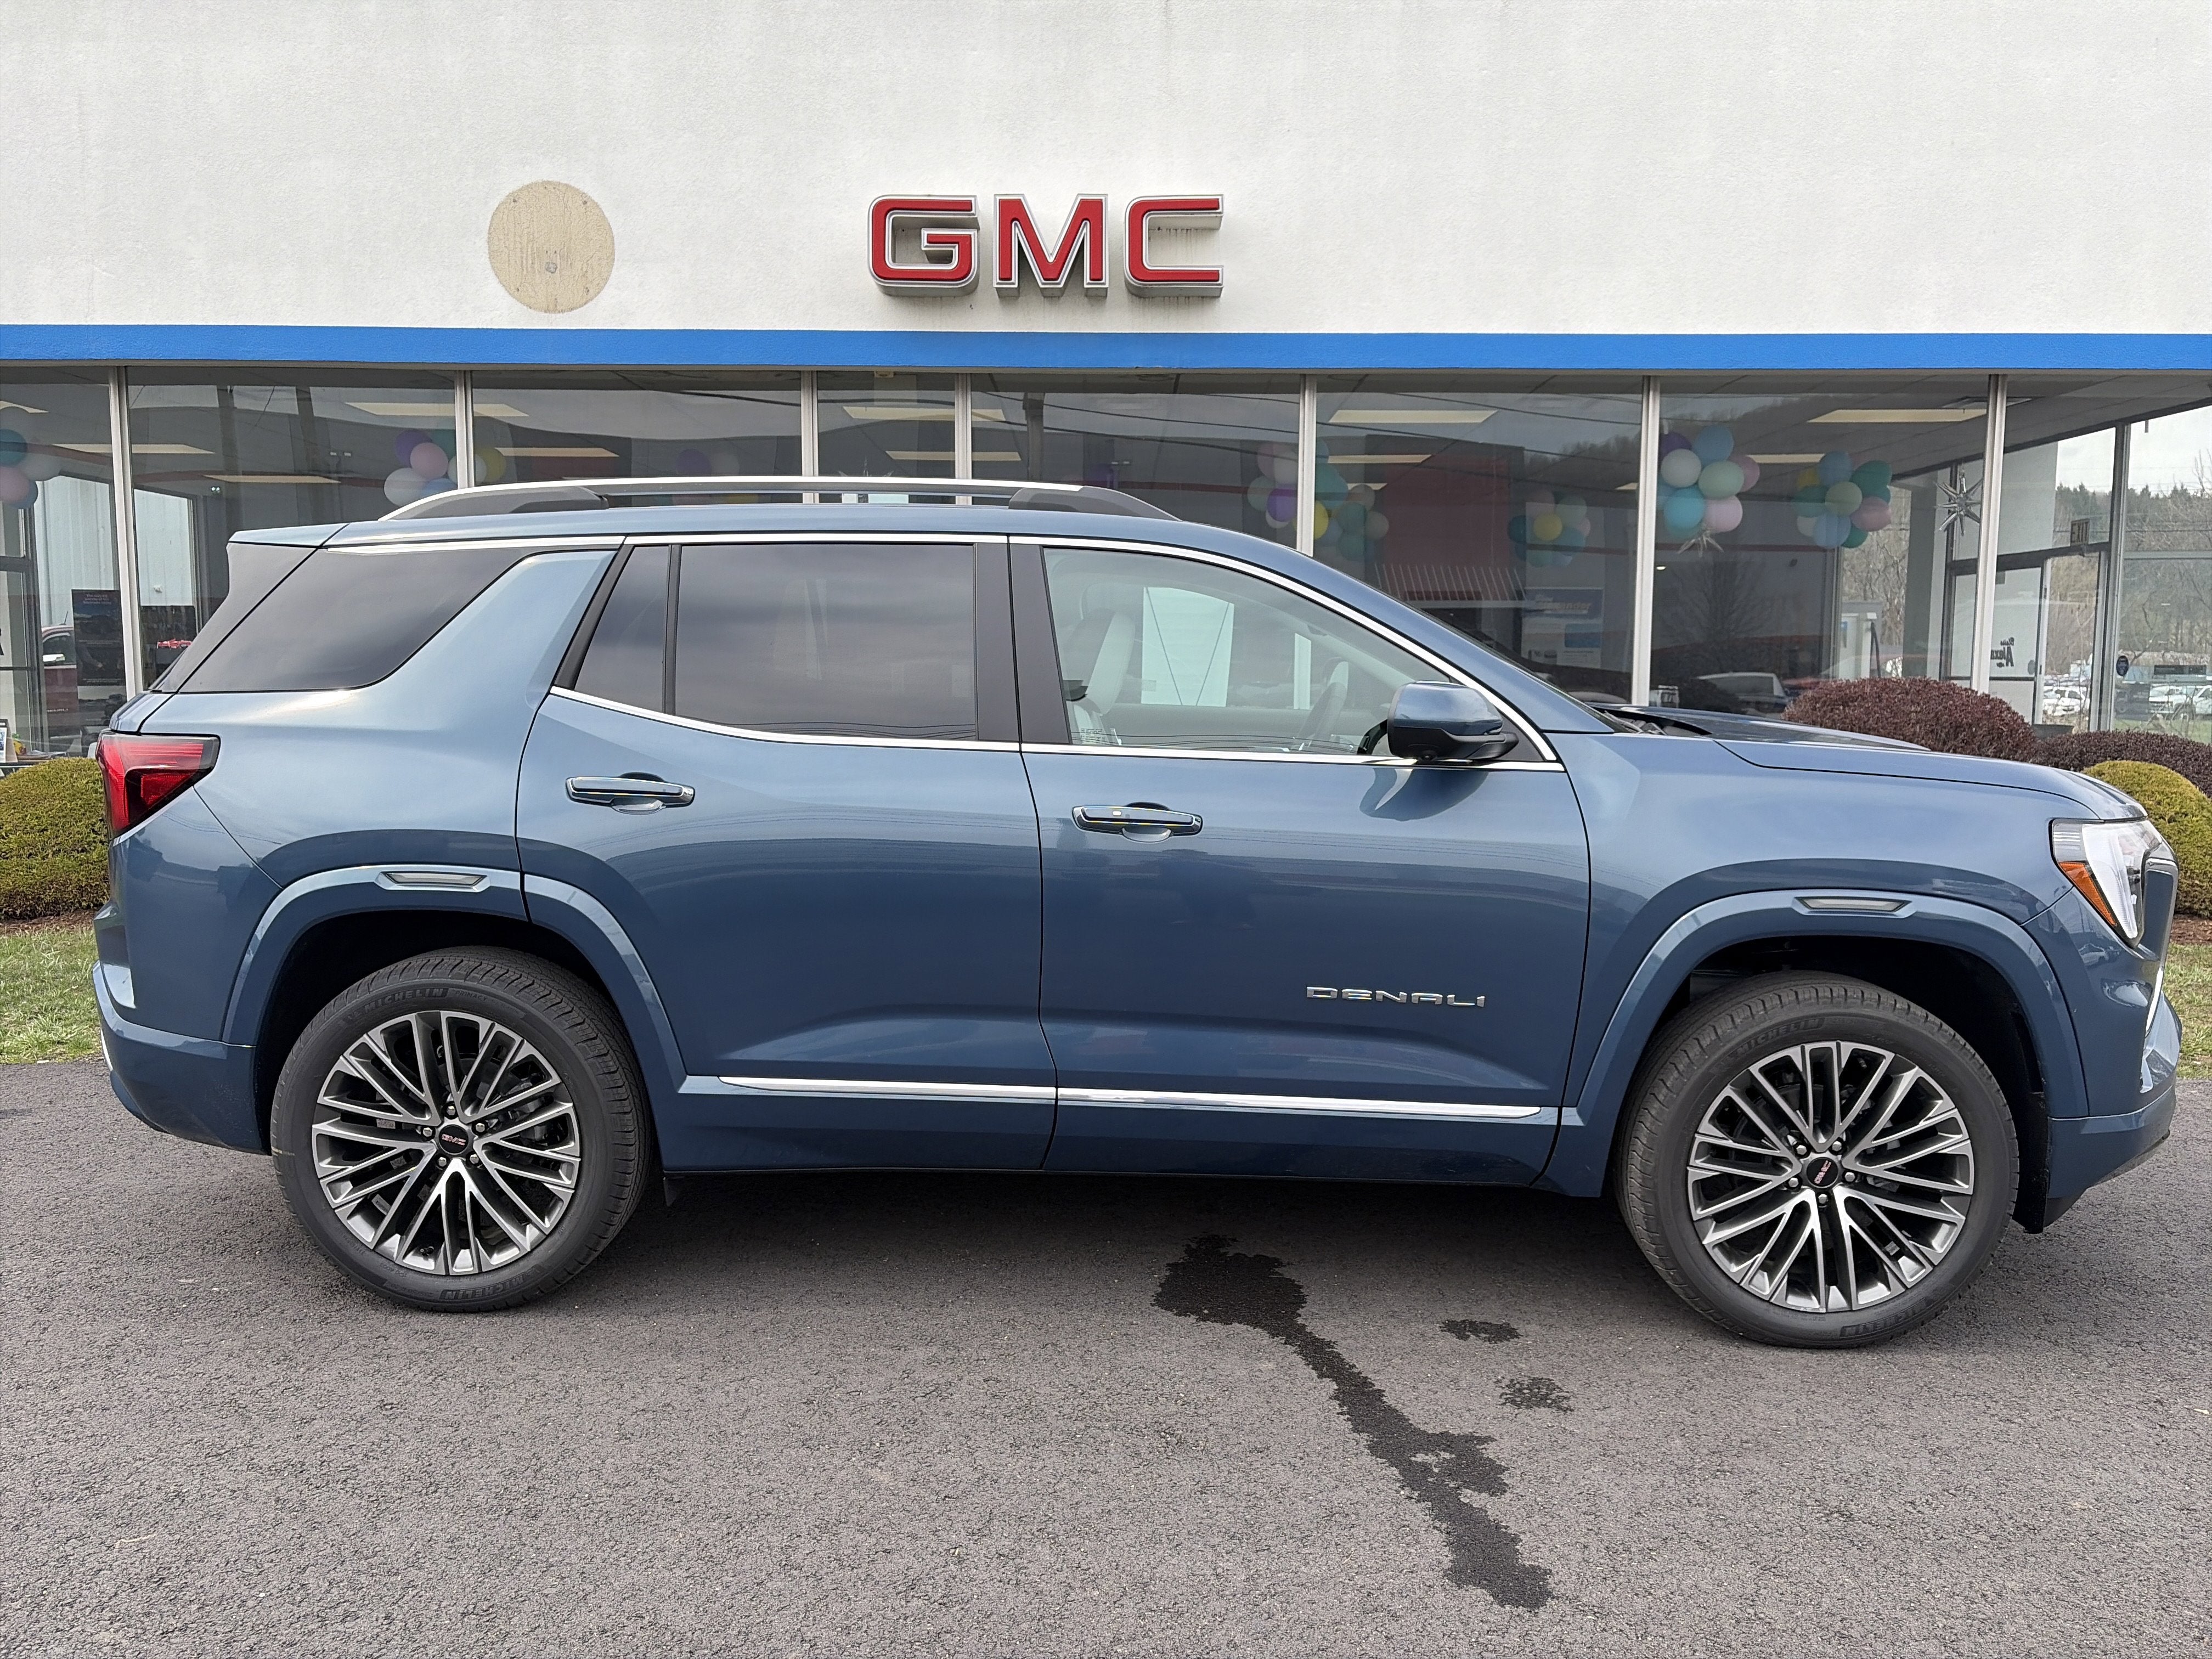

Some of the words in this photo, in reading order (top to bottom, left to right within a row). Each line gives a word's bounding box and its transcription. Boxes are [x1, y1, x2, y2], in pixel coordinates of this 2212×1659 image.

[867, 194, 1224, 295] GMC
[364, 988, 444, 1013] MICHELIN
[1306, 986, 1486, 1008] DENALI
[444, 1273, 524, 1300] MICHELIN
